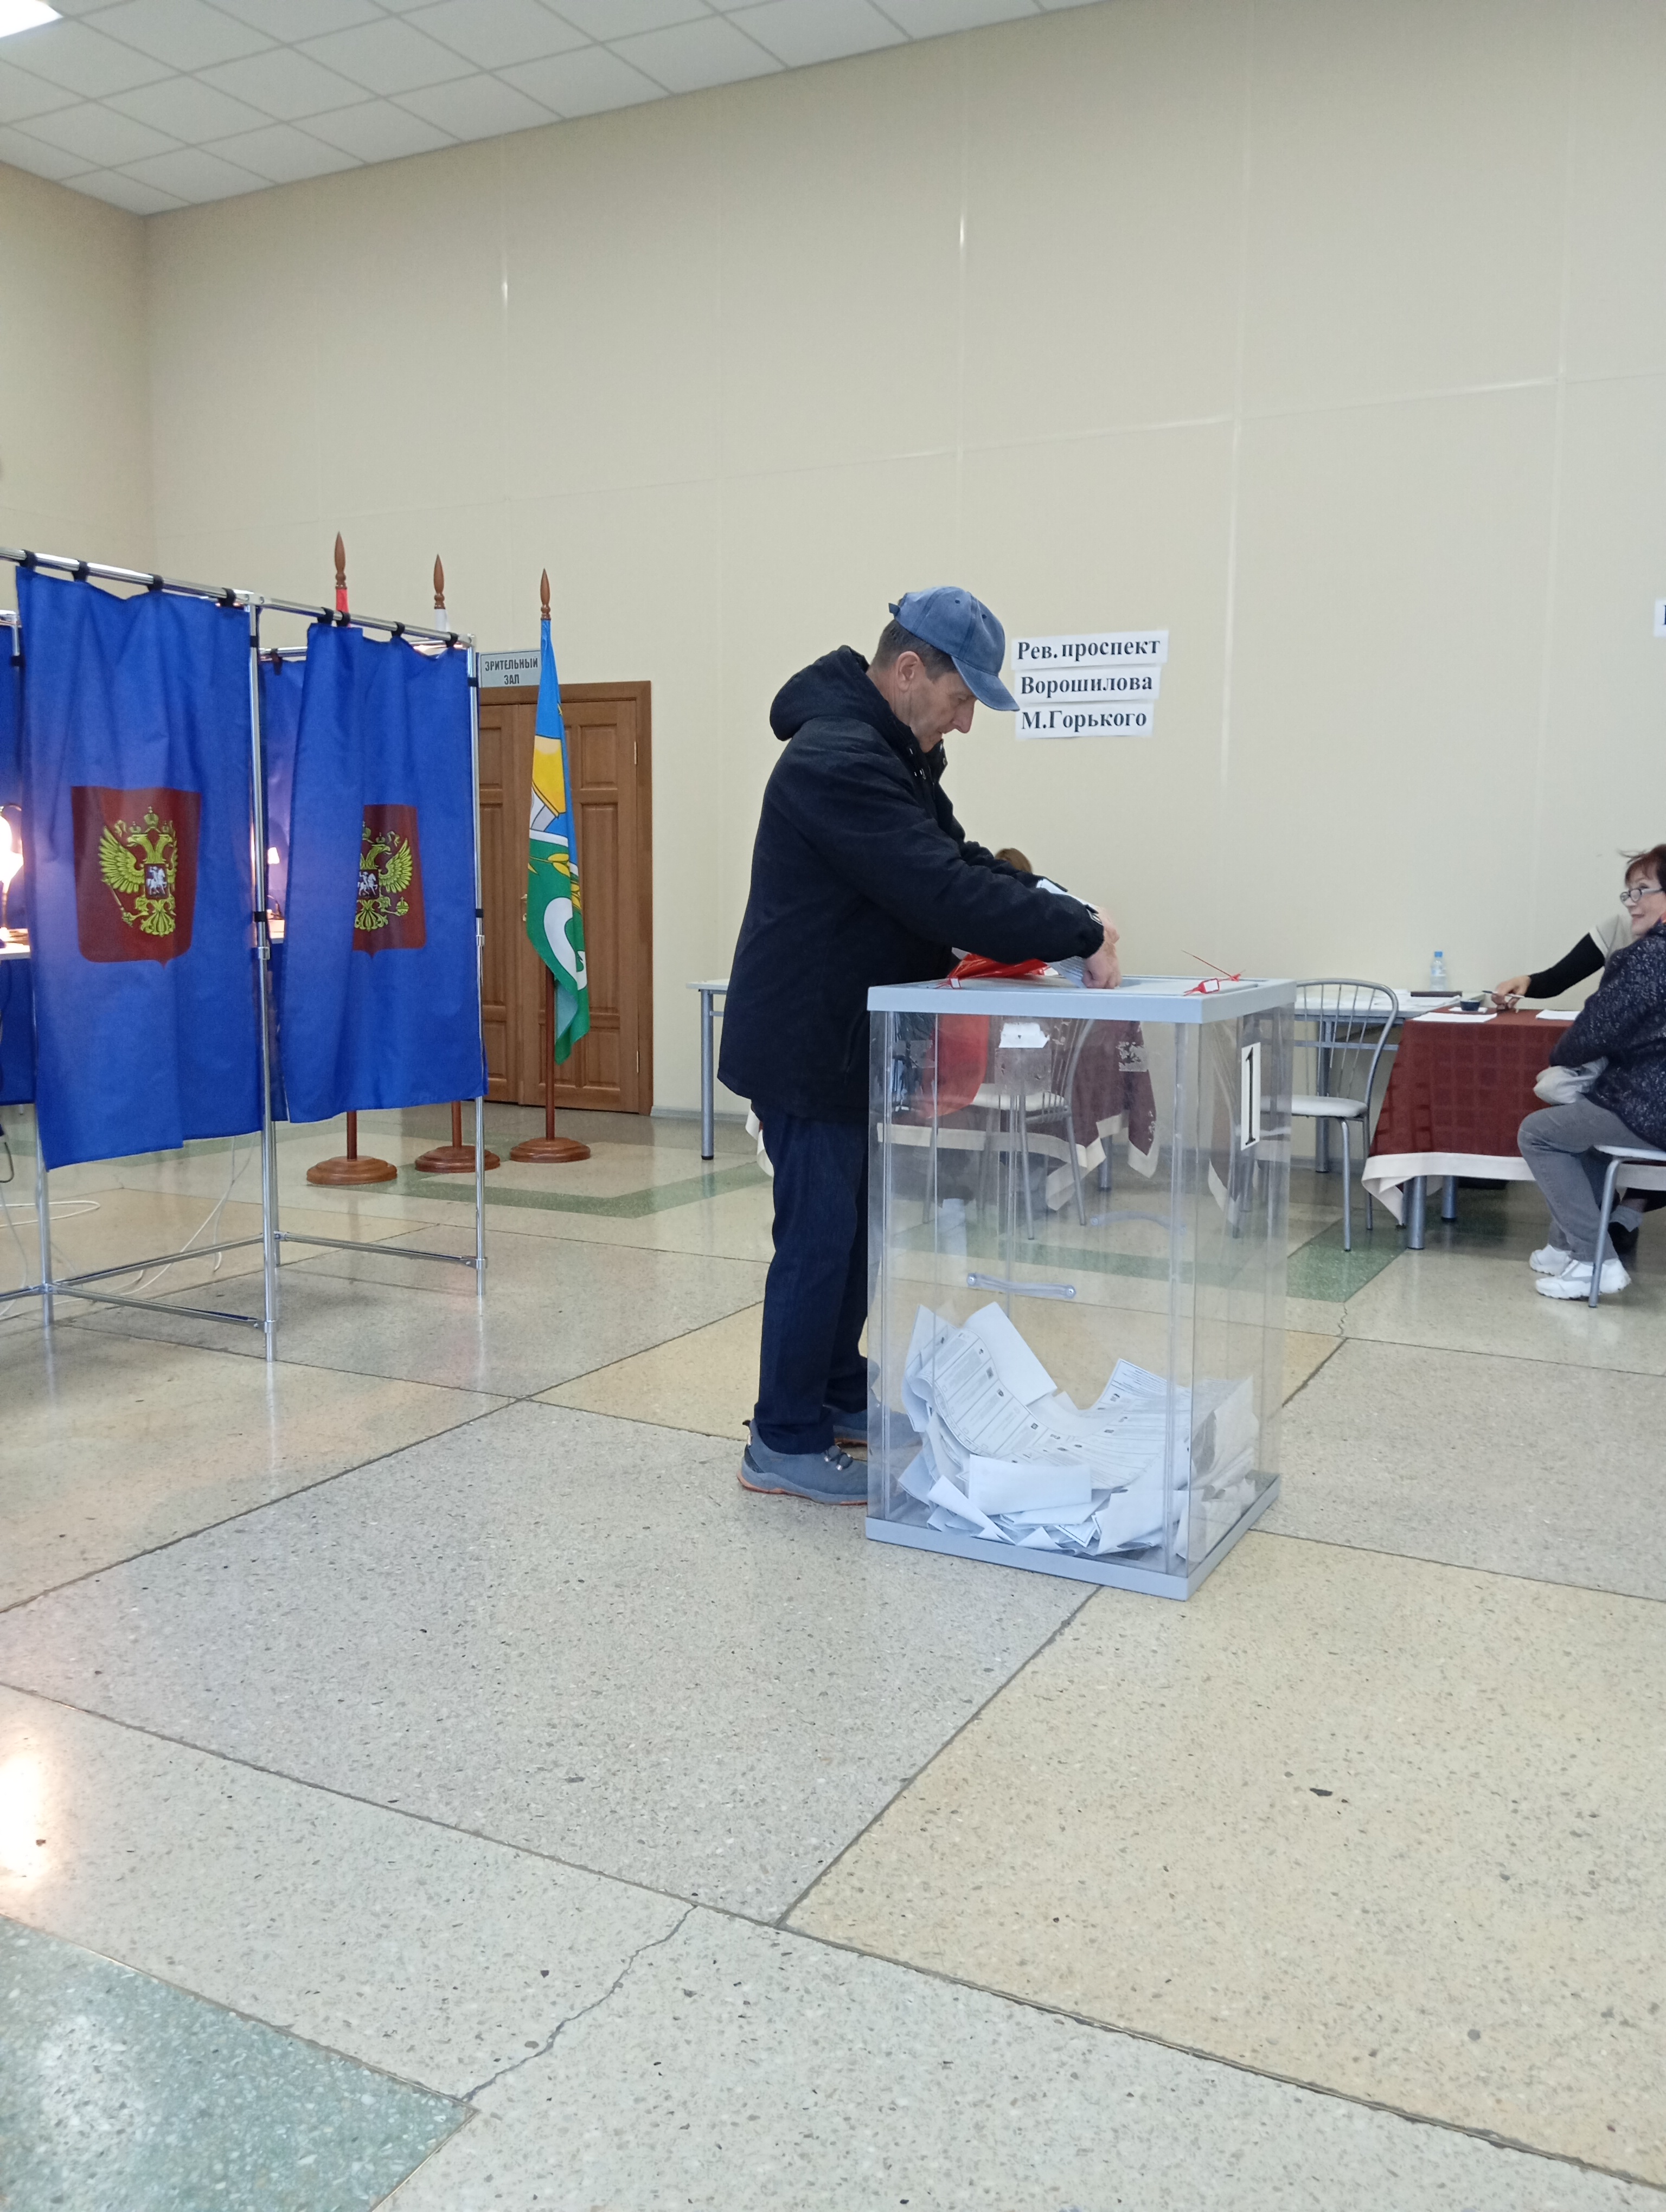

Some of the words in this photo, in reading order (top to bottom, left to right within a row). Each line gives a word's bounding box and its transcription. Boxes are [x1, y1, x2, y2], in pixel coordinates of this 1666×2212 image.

[1017, 641, 1058, 660] Рев.
[1062, 640, 1161, 662] проспект
[485, 656, 538, 671] ЗРИТЕЛЬНЫЙ
[504, 674, 520, 685] ЗАЛ
[1021, 676, 1153, 698] Ворошилова
